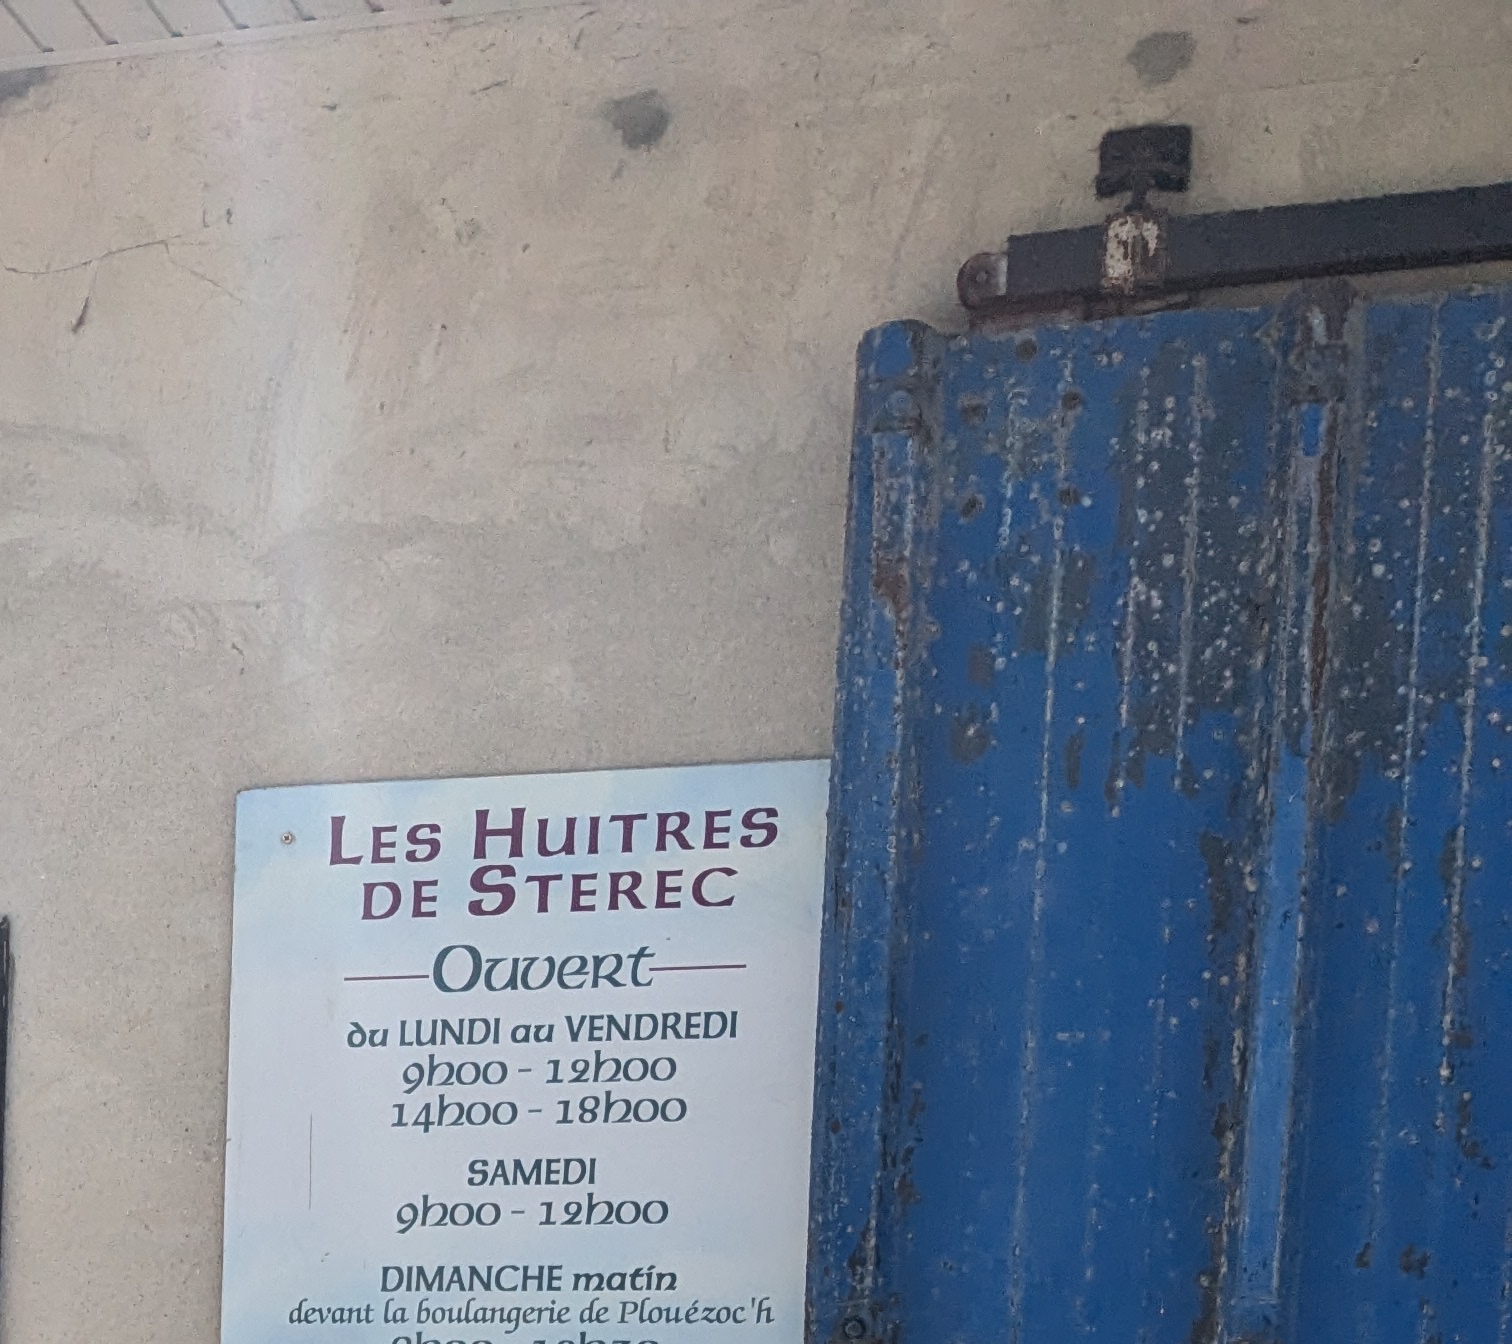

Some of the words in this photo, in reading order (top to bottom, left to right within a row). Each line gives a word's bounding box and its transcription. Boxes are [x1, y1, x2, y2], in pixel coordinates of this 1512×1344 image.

[329, 815, 442, 866] LES
[472, 806, 780, 860] HUITRES
[361, 879, 439, 921] DE
[468, 864, 739, 917] STEREC
[432, 944, 656, 993] Ouvert
[347, 1021, 389, 1049] du
[399, 1017, 501, 1048] LUNDI
[510, 1020, 555, 1046] au
[565, 1010, 740, 1042] VENDREDI
[402, 1053, 508, 1094] 9h00
[545, 1048, 678, 1086] 12h00
[391, 1093, 519, 1135] 14h00
[555, 1089, 688, 1126] 18h00
[467, 1157, 597, 1187] SAMEDI
[395, 1195, 501, 1235] 9h00
[538, 1193, 670, 1227] 12h00
[380, 1264, 563, 1294] DIMANCHE
[572, 1265, 679, 1293] matin
[288, 1298, 375, 1326] devant
[382, 1298, 409, 1325] la
[416, 1299, 572, 1334] boulangerie
[579, 1298, 610, 1325] de
[619, 1296, 775, 1326] Plouézoc'h
